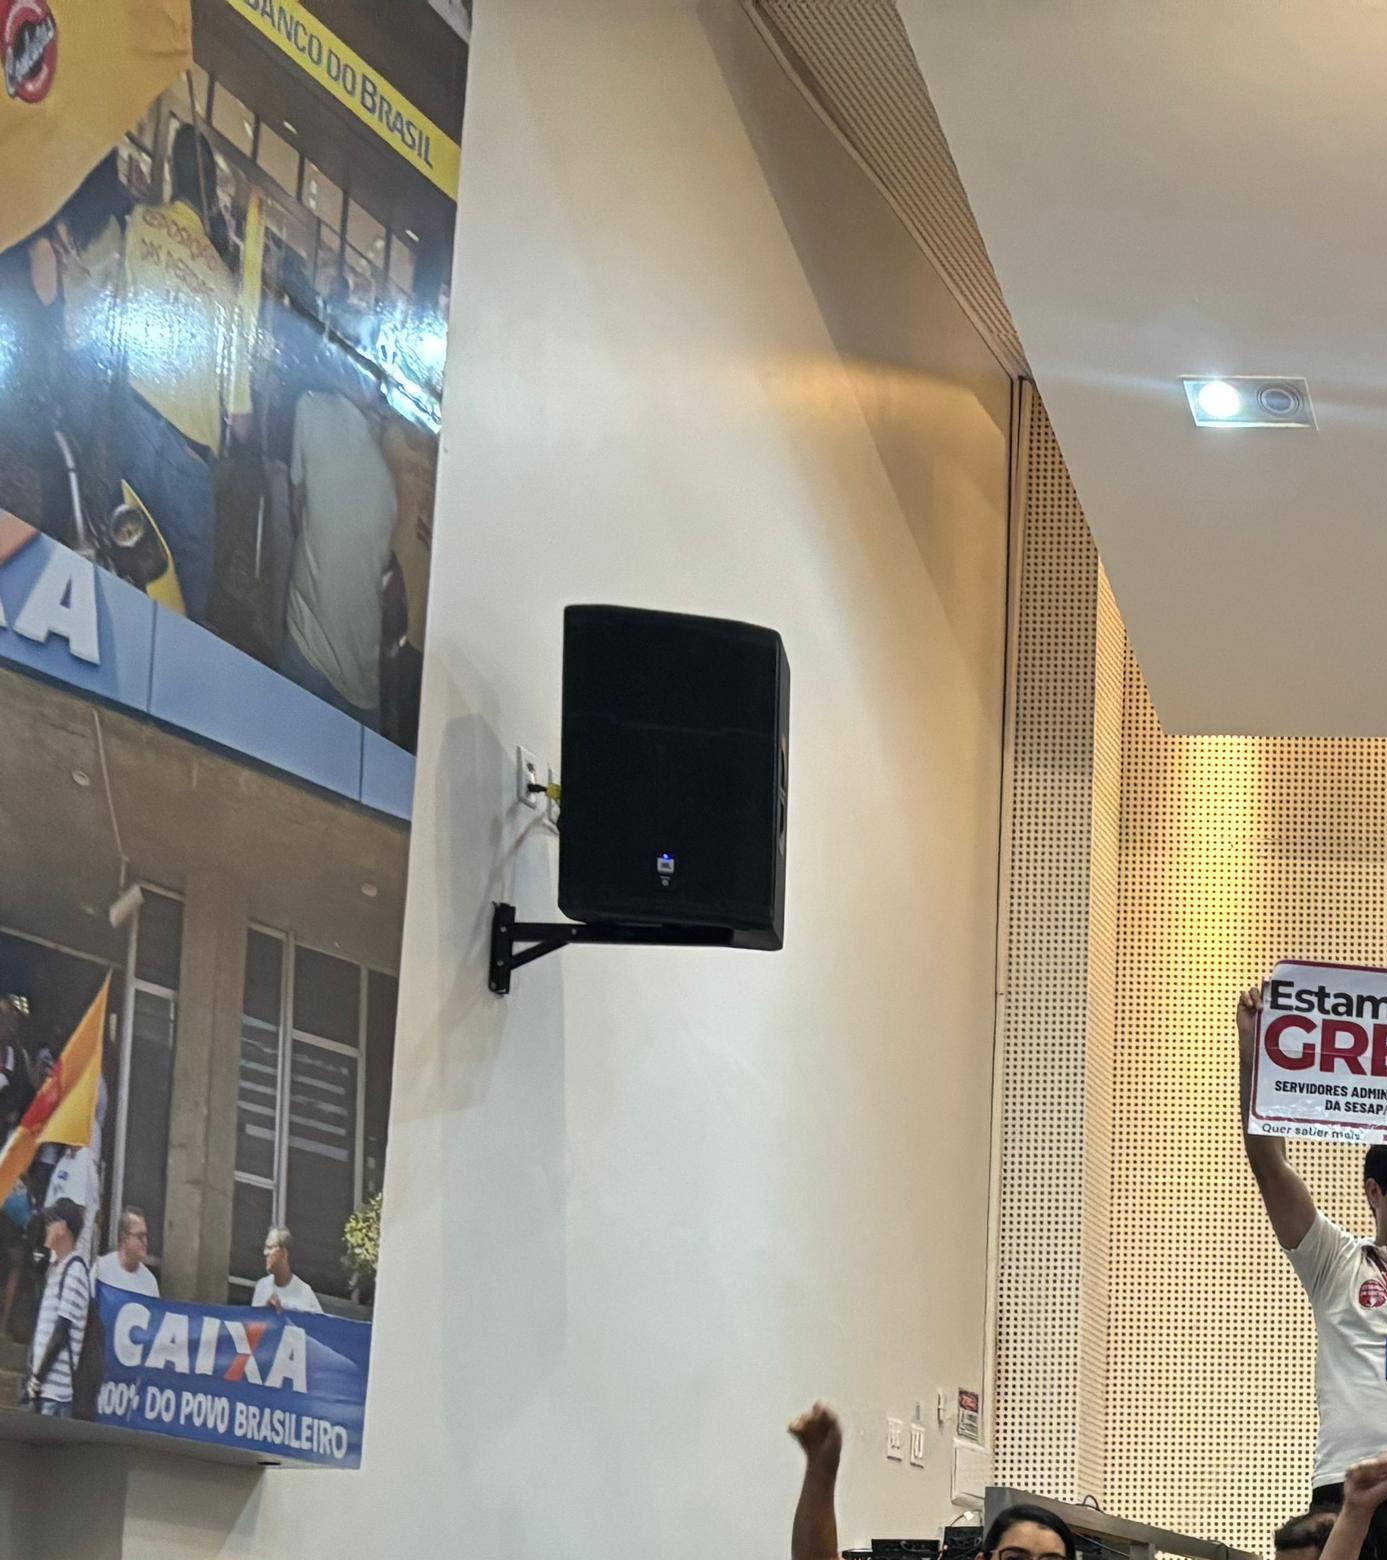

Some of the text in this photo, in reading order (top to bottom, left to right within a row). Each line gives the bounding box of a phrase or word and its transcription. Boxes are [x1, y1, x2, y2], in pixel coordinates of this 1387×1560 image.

[326, 50, 357, 97] DO
[360, 72, 434, 170] BRASIL
[1275, 1080, 1348, 1098] SERVIDORES
[1325, 1100, 1342, 1113] DA
[113, 1302, 308, 1393] CAIXA
[144, 1386, 176, 1424] DO
[180, 1391, 230, 1434] POVO
[234, 1401, 348, 1460] BRASILEIRO
